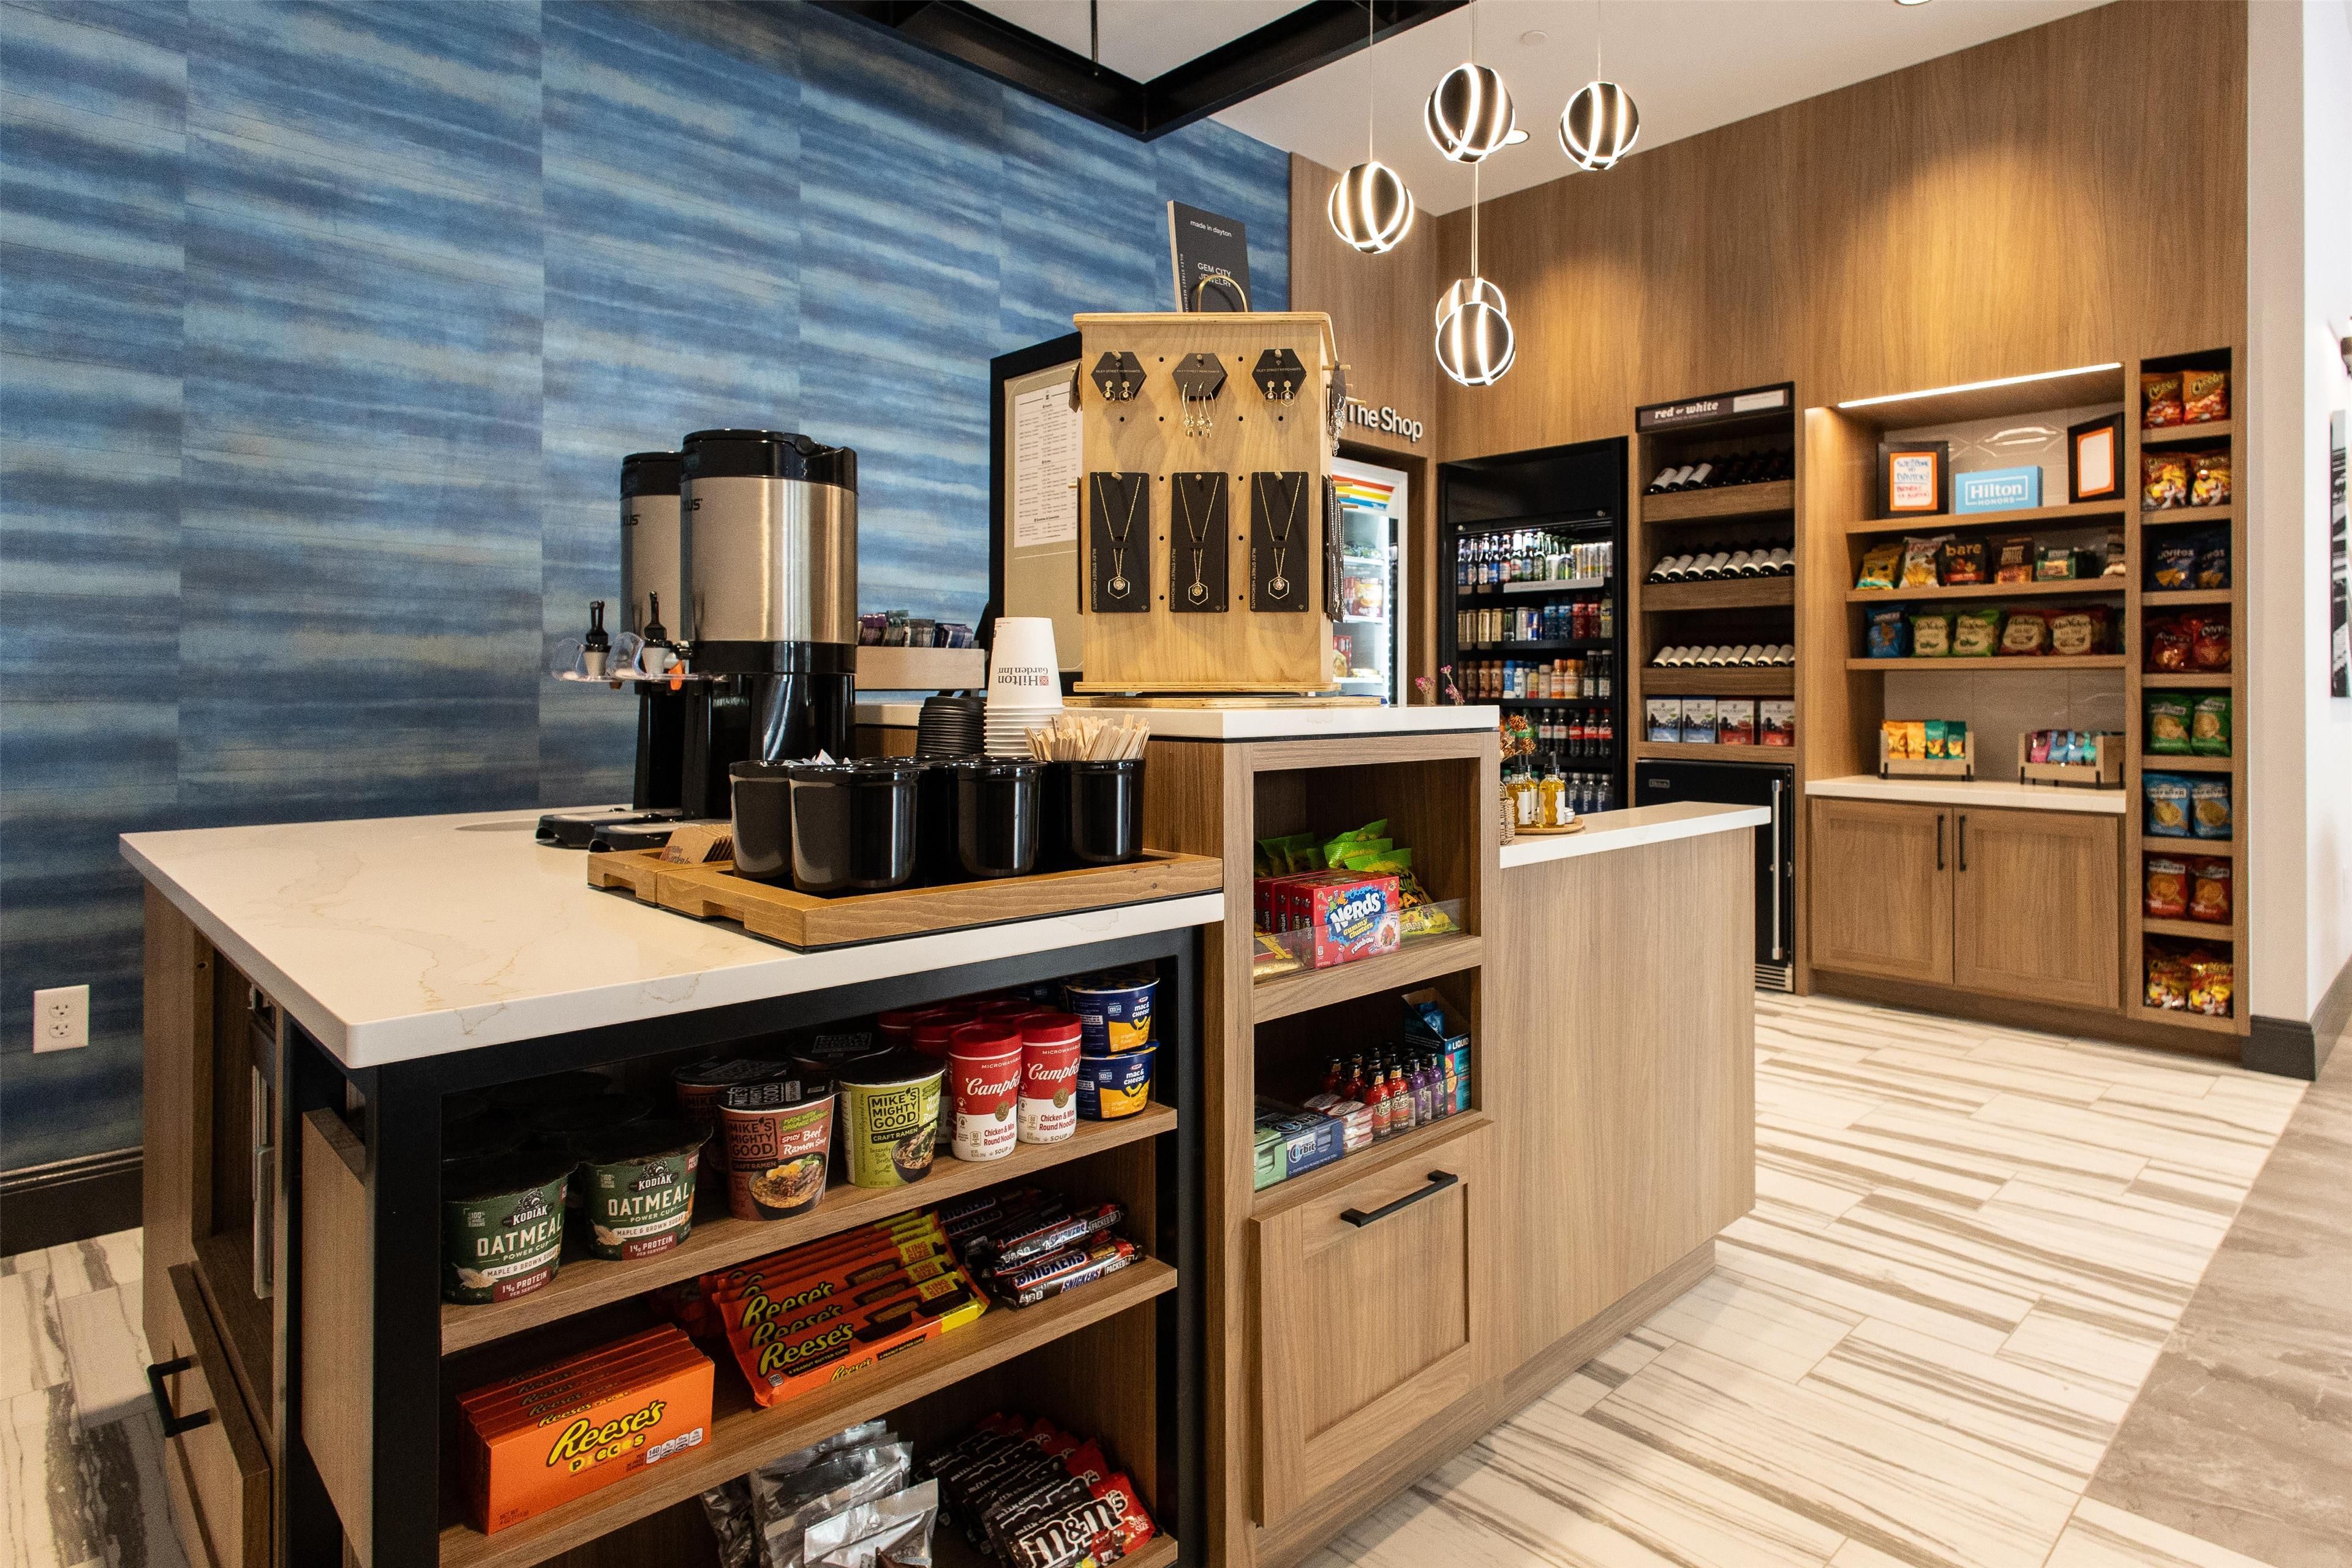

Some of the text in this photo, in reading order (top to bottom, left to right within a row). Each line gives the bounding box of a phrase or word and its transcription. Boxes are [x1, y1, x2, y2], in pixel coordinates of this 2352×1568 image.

[1190, 221, 1206, 230] made
[1213, 227, 1232, 238] dayton
[1197, 263, 1232, 277] GEM CITY
[1655, 407, 1675, 419] red
[1686, 402, 1719, 415] white
[1349, 404, 1423, 435] The Shop
[1970, 482, 2022, 499] Hilton
[1978, 497, 2015, 506] HONORS
[1945, 543, 1982, 557] bare
[998, 675, 1039, 686] Hilton
[1351, 937, 1374, 954] rainbow
[1452, 1038, 1469, 1050] LIQUID
[872, 1091, 917, 1107] MIKE'S
[873, 1101, 917, 1117] MIGHTY
[874, 1112, 916, 1129] GOOD
[1041, 1114, 1063, 1122] Chicken
[729, 1121, 773, 1134] MIKE'S
[783, 1122, 809, 1131] ORGANIC
[984, 1126, 1005, 1137] Chicken
[1039, 1121, 1058, 1131] Round
[730, 1133, 773, 1144] MIGHTY
[782, 1125, 823, 1144] SPICY Beef
[873, 1127, 918, 1142] CRAFT RAMEN
[984, 1136, 1001, 1146] Round
[1050, 1133, 1068, 1142] SOUP
[732, 1144, 773, 1156] GOOD
[783, 1140, 815, 1155] Ramen
[995, 1146, 1009, 1155] SOUP
[1288, 1142, 1316, 1163] Orbit
[638, 1174, 673, 1191] KODIAK
[608, 1182, 689, 1216] OATMEAL
[513, 1204, 548, 1226] KODIAK
[630, 1213, 658, 1223] POWER
[646, 1222, 667, 1232] BROWN
[668, 1213, 685, 1225] SUGAR
[1091, 1216, 1110, 1231] PACKED
[477, 1213, 562, 1257] OATMEAL
[643, 1235, 673, 1250] PROTEIN
[503, 1240, 549, 1261] POWER CUP
[647, 1245, 668, 1255] SERVING
[909, 1250, 930, 1262] SIZE
[487, 1267, 511, 1278] MAPLE
[520, 1256, 542, 1270] BROWN
[543, 1248, 560, 1263] SUGAR
[912, 1261, 935, 1273] KING
[1015, 1253, 1085, 1286] SNICKERS
[916, 1268, 938, 1280] SIZE
[1063, 1260, 1126, 1291] SNICKERS PACKED
[502, 1270, 548, 1294] 14g PROTEIN
[521, 1282, 542, 1294] SERVING
[742, 1241, 928, 1329] Reese's KING
[930, 1285, 951, 1297] SIZE
[759, 1279, 949, 1376] Reese's KING
[793, 1361, 814, 1373] PEANUT
[815, 1354, 835, 1365] BUTTER
[835, 1348, 849, 1357] CUPS
[831, 1357, 873, 1381] Reese's
[538, 1403, 592, 1428] Reese's
[548, 1400, 666, 1466] Reese's
[649, 1447, 660, 1457] 140
[996, 1479, 1060, 1520] milk chocolate
[1015, 1521, 1039, 1536] milk
[1135, 1523, 1150, 1534] SIZE
